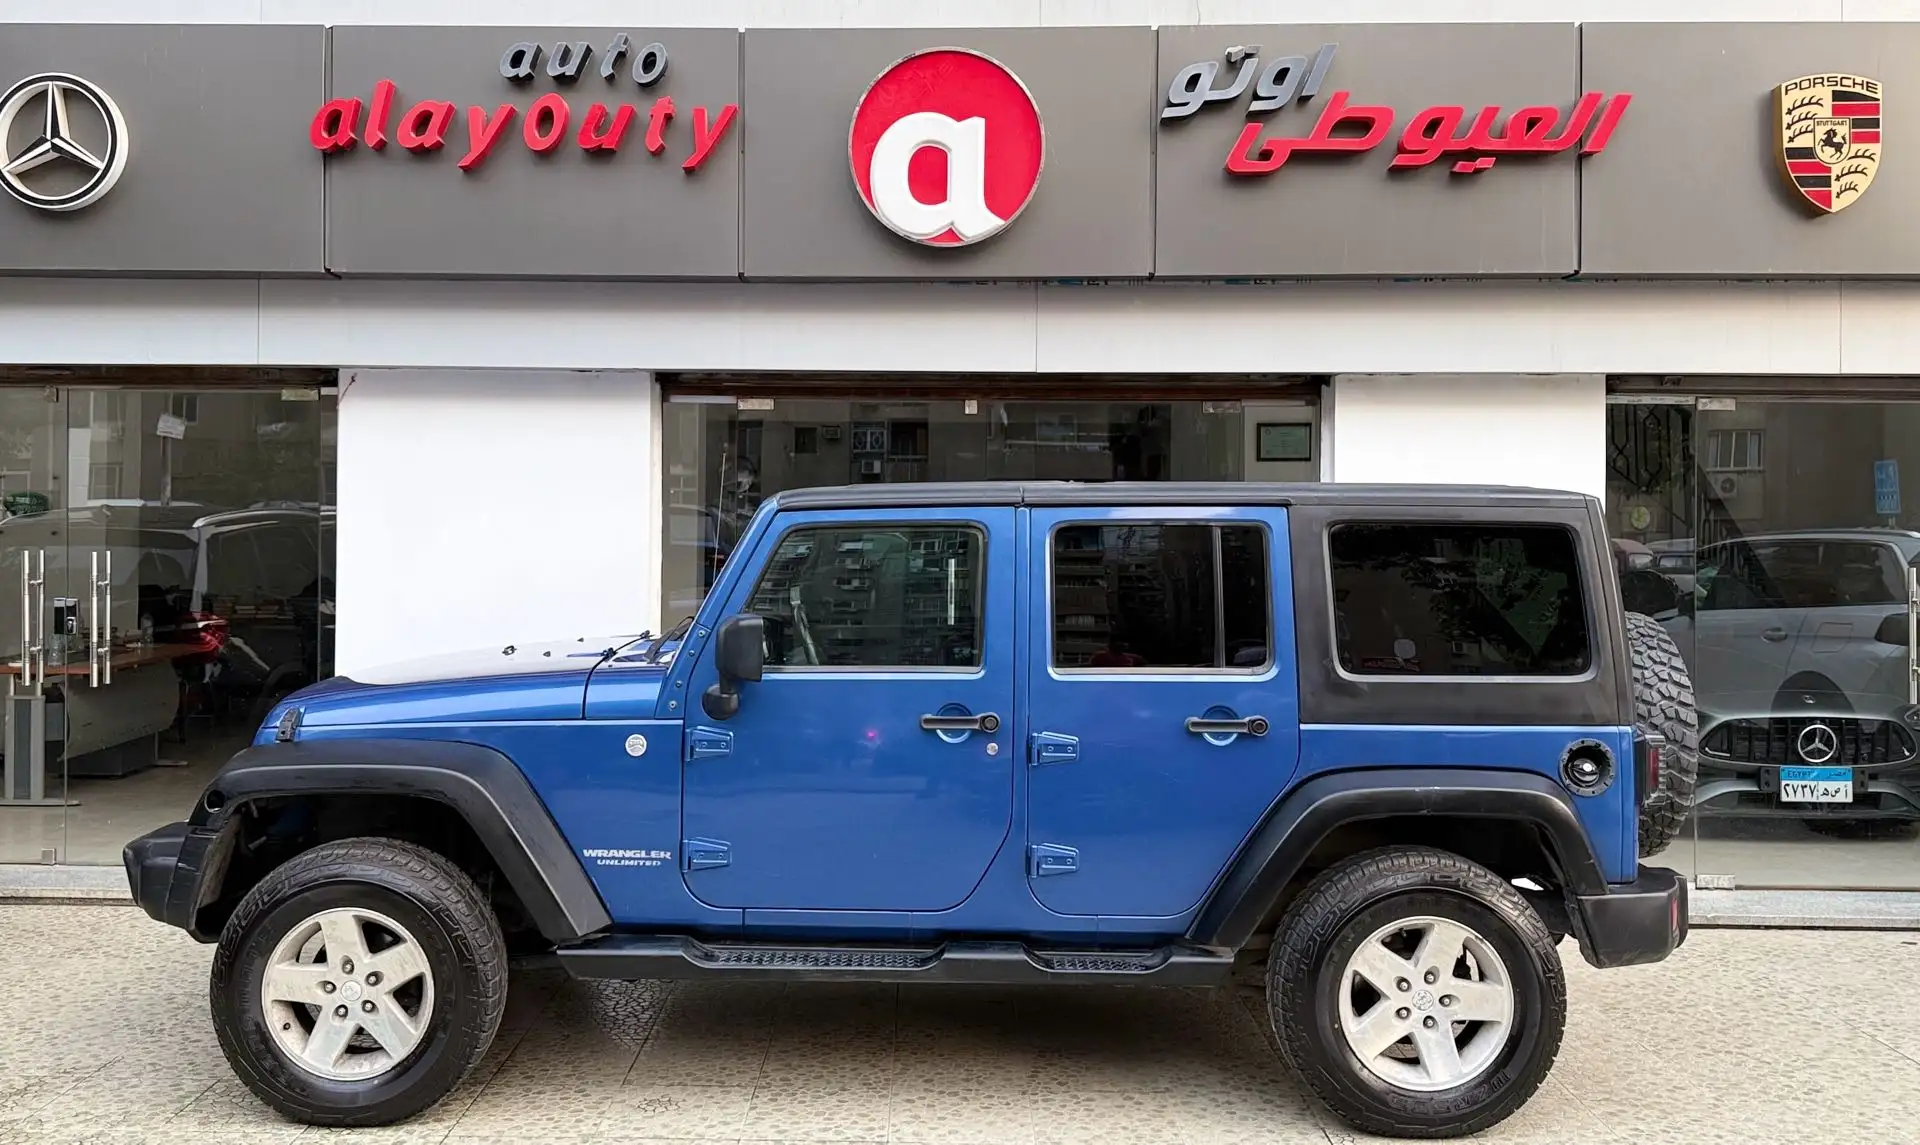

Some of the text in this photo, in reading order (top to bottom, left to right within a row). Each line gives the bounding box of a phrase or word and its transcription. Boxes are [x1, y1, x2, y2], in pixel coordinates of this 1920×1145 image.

[500, 32, 669, 87] auto
[1161, 42, 1339, 123] اوتو
[1784, 76, 1878, 95] PORSCHE
[310, 79, 738, 173] alayouty
[870, 111, 1006, 239] a
[582, 849, 672, 859] WRANGLER
[597, 859, 661, 867] UNLIMITED
